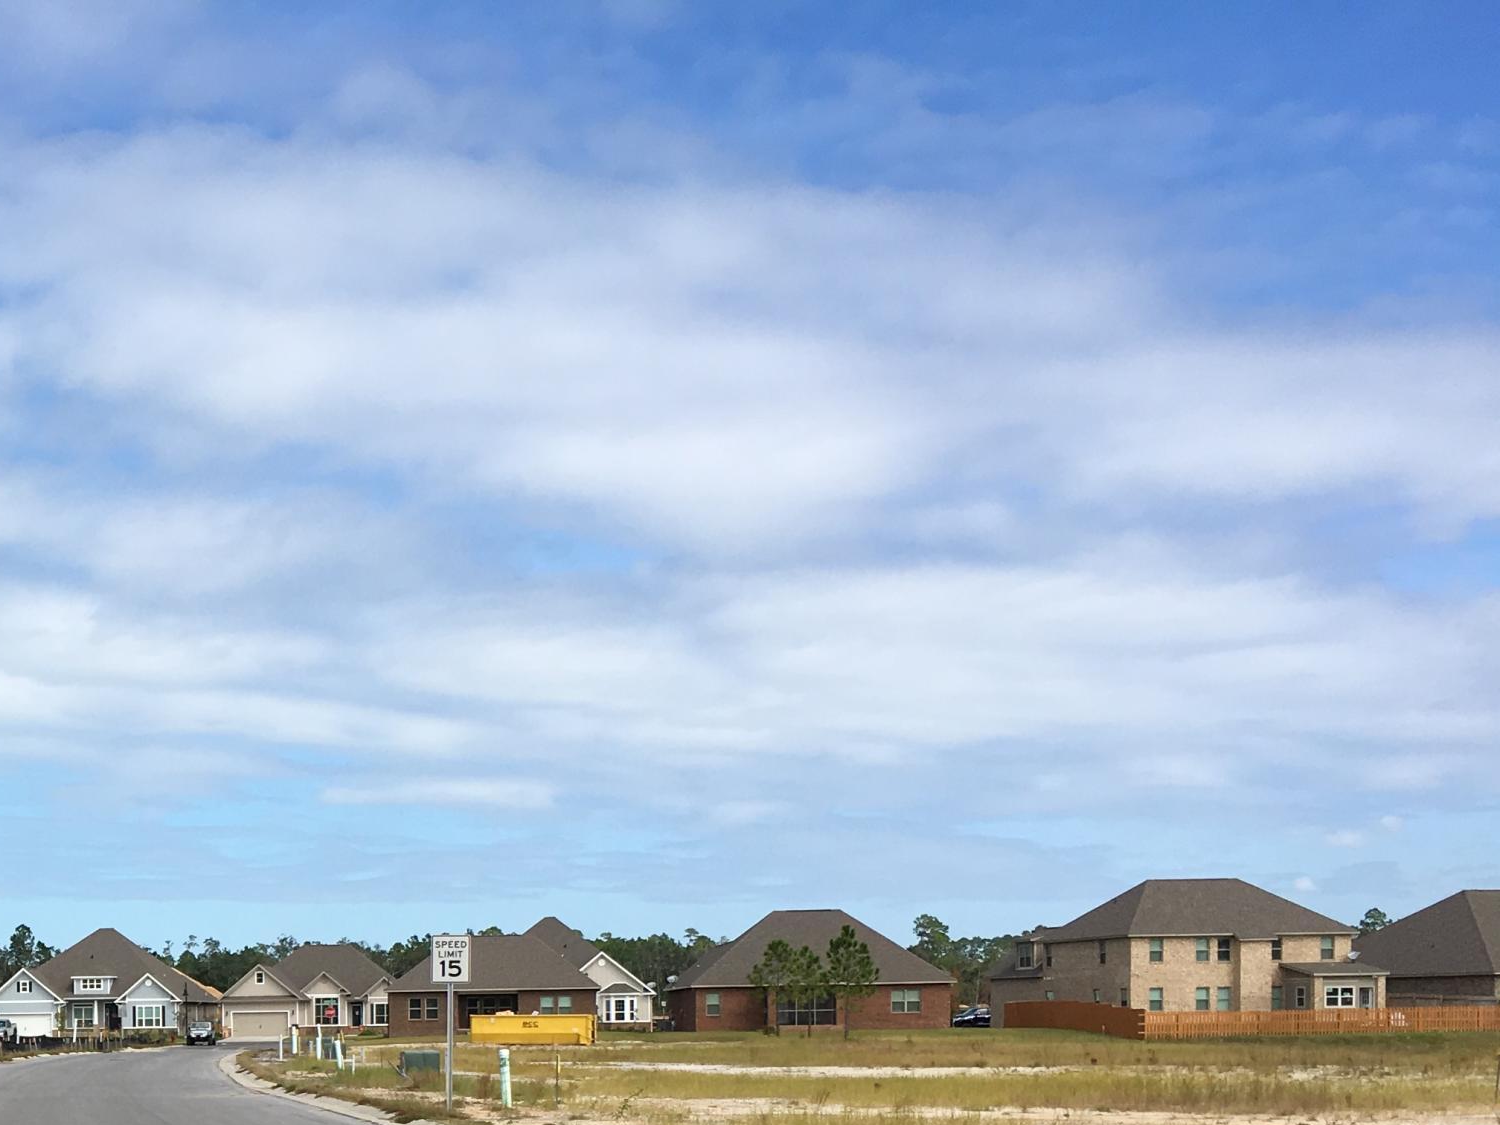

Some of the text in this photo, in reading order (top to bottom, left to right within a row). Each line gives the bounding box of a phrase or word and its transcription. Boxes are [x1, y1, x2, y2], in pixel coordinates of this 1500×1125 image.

[435, 940, 467, 949] SPEED
[438, 950, 463, 958] LIMIT
[439, 960, 462, 977] 15
